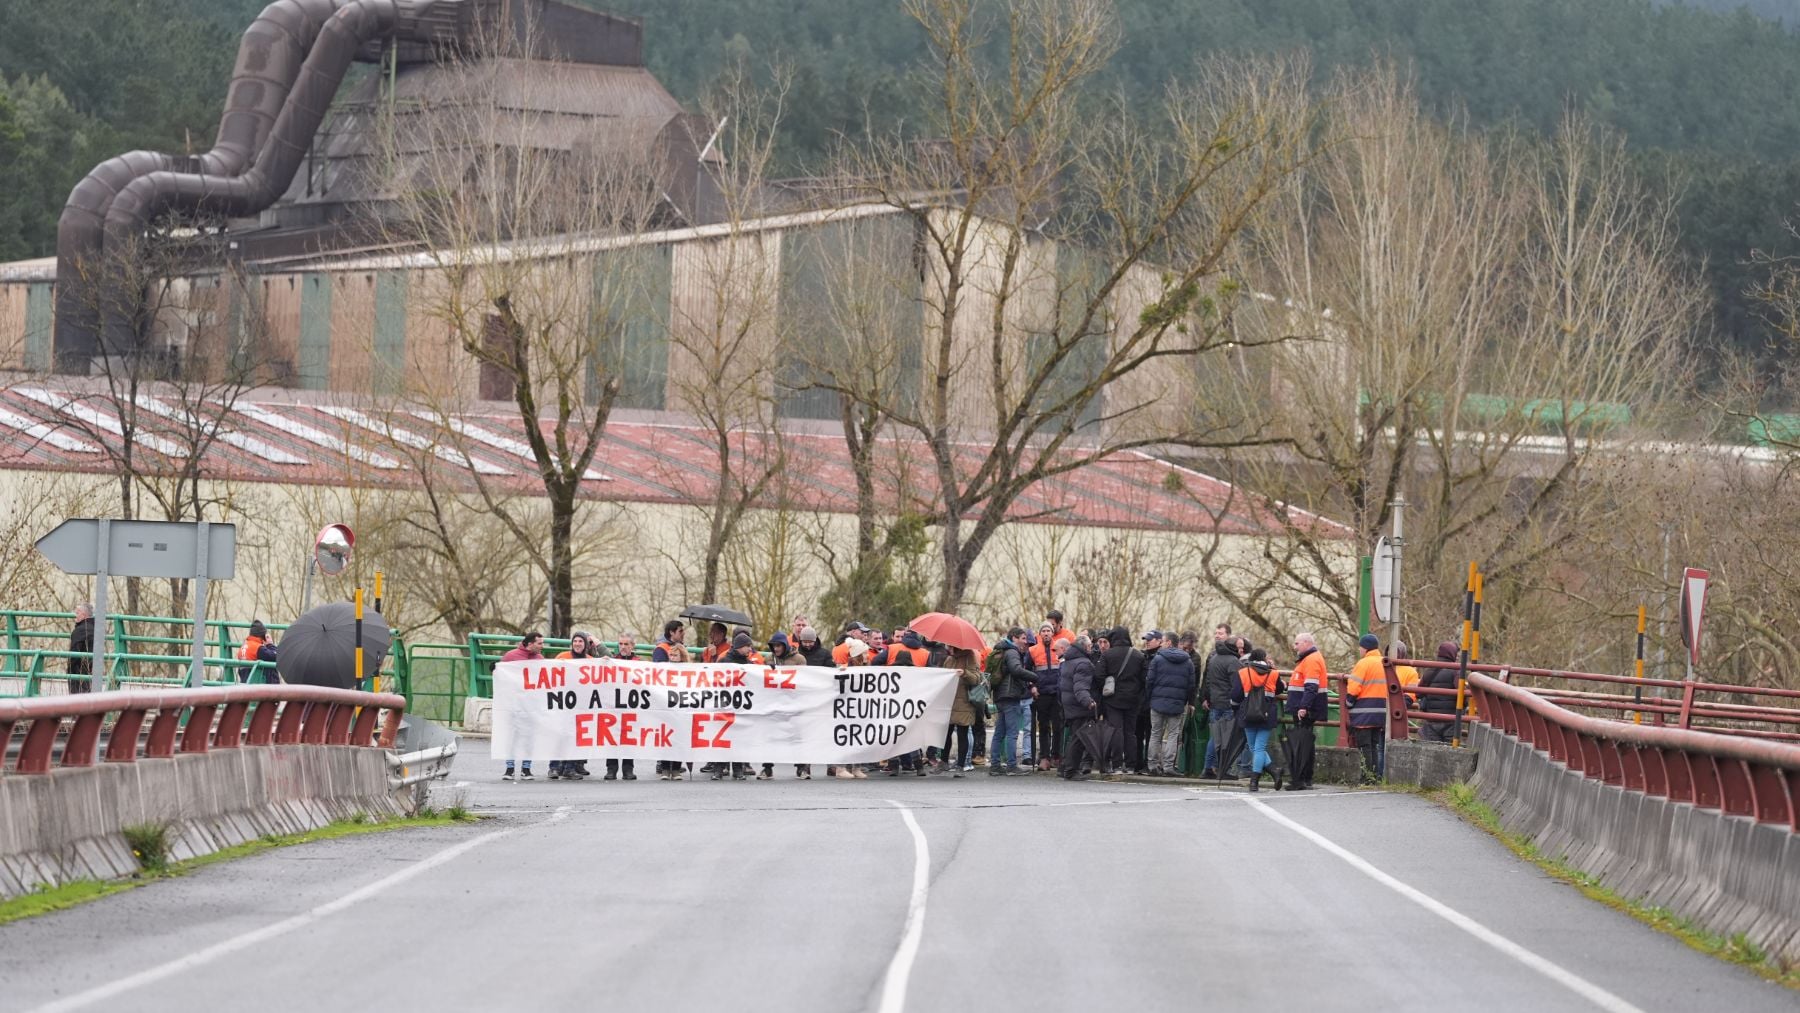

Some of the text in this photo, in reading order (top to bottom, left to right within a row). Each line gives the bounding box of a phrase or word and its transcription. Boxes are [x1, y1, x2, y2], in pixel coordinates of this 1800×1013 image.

[522, 666, 566, 690] LAN
[763, 669, 797, 690] EZ
[834, 671, 902, 695] TUBOS
[546, 690, 577, 710] NO
[588, 689, 603, 709] A
[614, 688, 651, 710] LOS
[575, 711, 736, 750] ERErik EZ
[833, 723, 907, 747] GROUP
